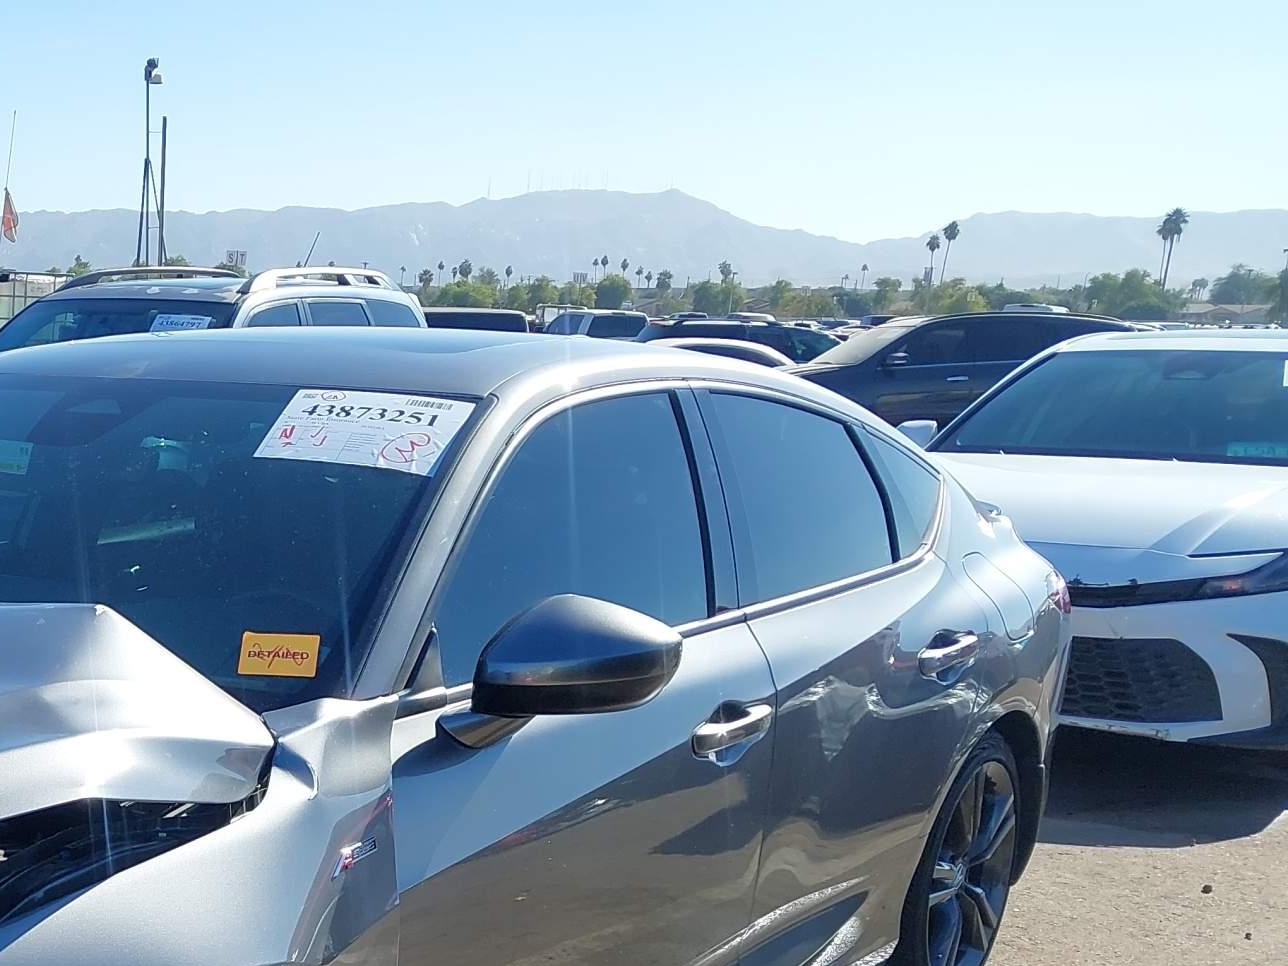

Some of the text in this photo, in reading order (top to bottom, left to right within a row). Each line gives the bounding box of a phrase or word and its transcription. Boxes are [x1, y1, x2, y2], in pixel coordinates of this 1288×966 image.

[228, 253, 246, 264] S T
[302, 403, 439, 427] 43873251
[248, 650, 309, 660] DETAILED
